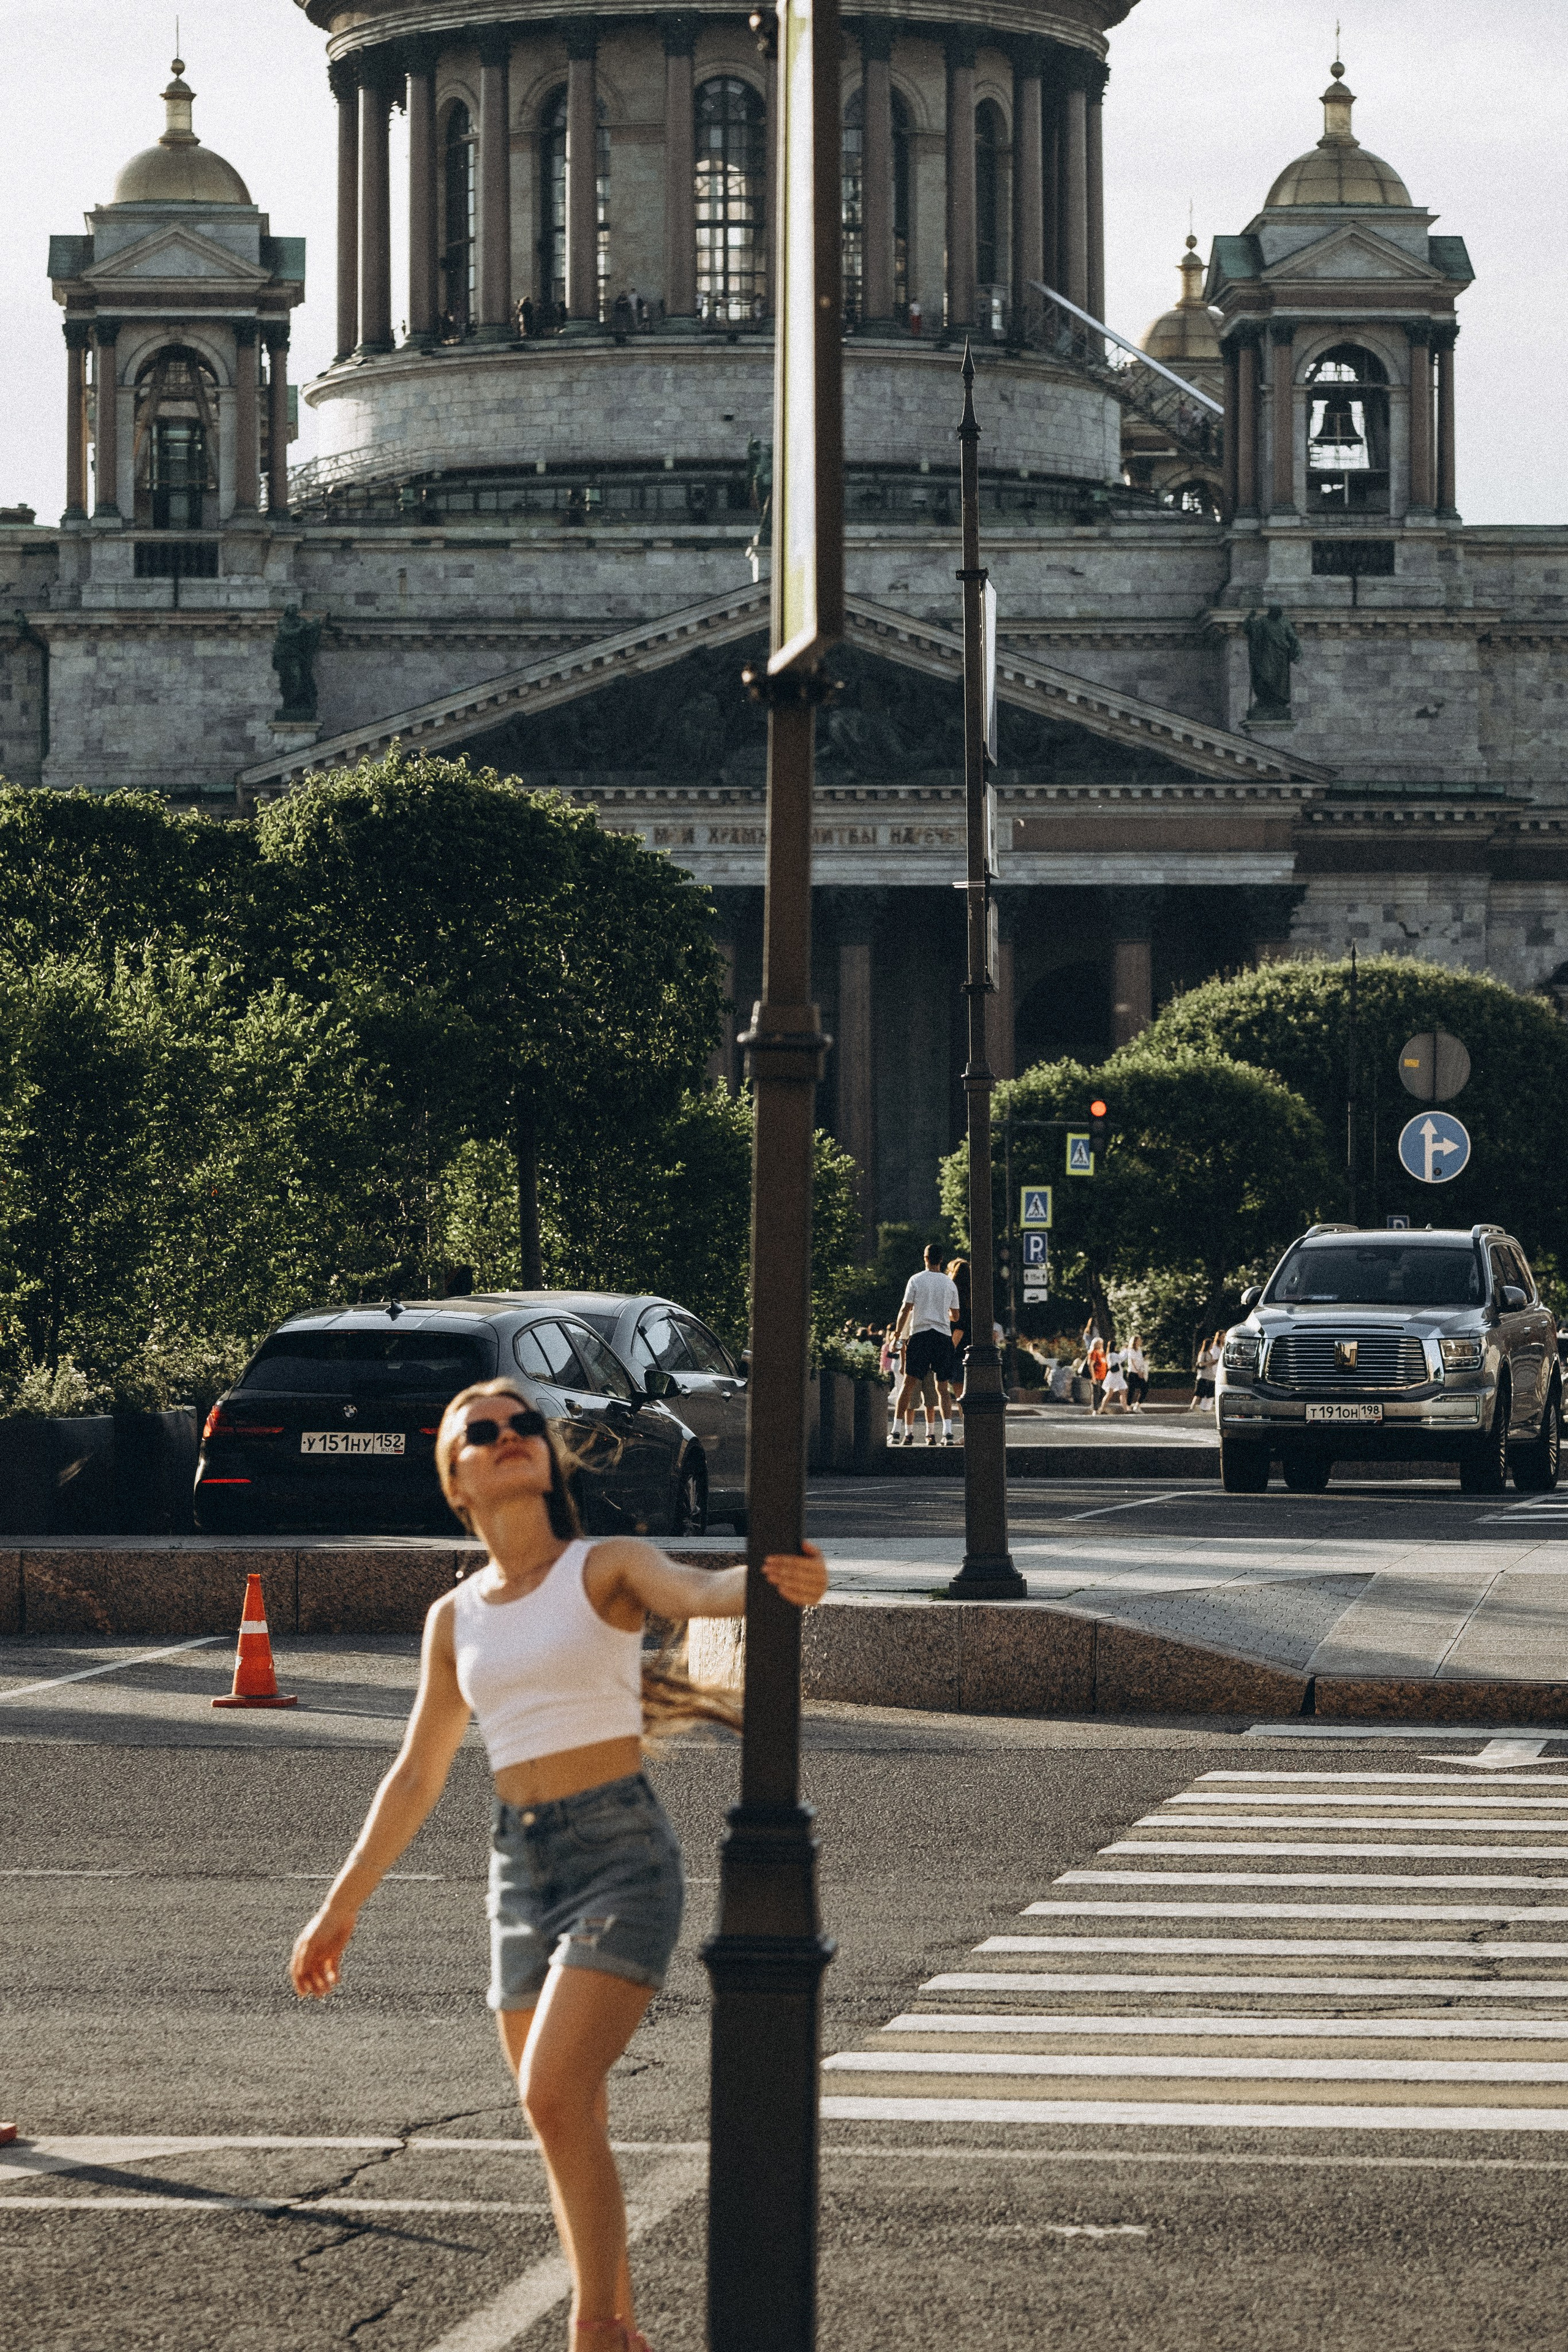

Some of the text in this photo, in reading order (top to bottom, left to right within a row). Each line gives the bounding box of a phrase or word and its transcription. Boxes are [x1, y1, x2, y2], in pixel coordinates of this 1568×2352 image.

[1030, 1236, 1043, 1261] P
[1310, 1405, 1379, 1418] Т191ОН 198
[307, 1434, 401, 1452] У151НУ 152
